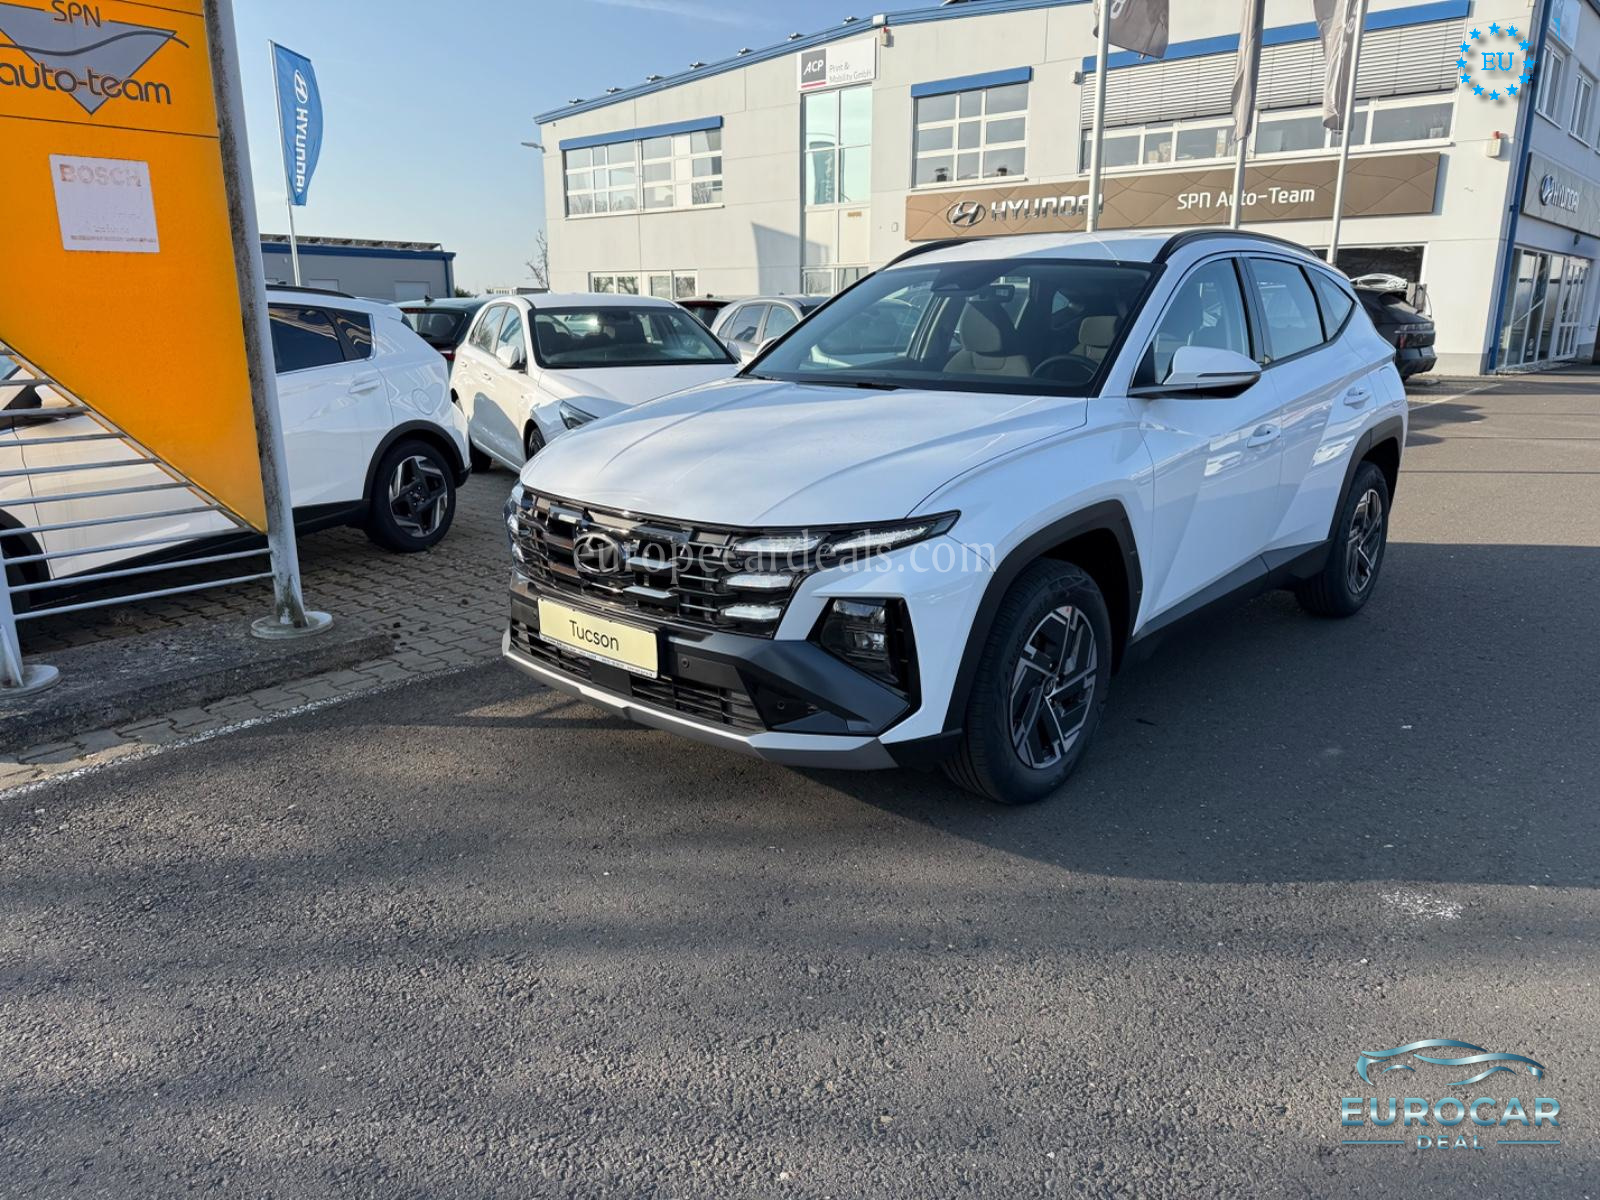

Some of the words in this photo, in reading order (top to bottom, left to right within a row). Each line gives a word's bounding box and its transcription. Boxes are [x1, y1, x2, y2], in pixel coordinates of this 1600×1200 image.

[52, 0, 101, 27] SPN
[803, 60, 824, 75] ACP
[0, 62, 172, 104] auto-team
[296, 107, 309, 193] HYUNDAI
[991, 193, 1104, 222] HYUNDAI
[1177, 191, 1211, 210] SPN
[569, 619, 619, 651] Tucson
